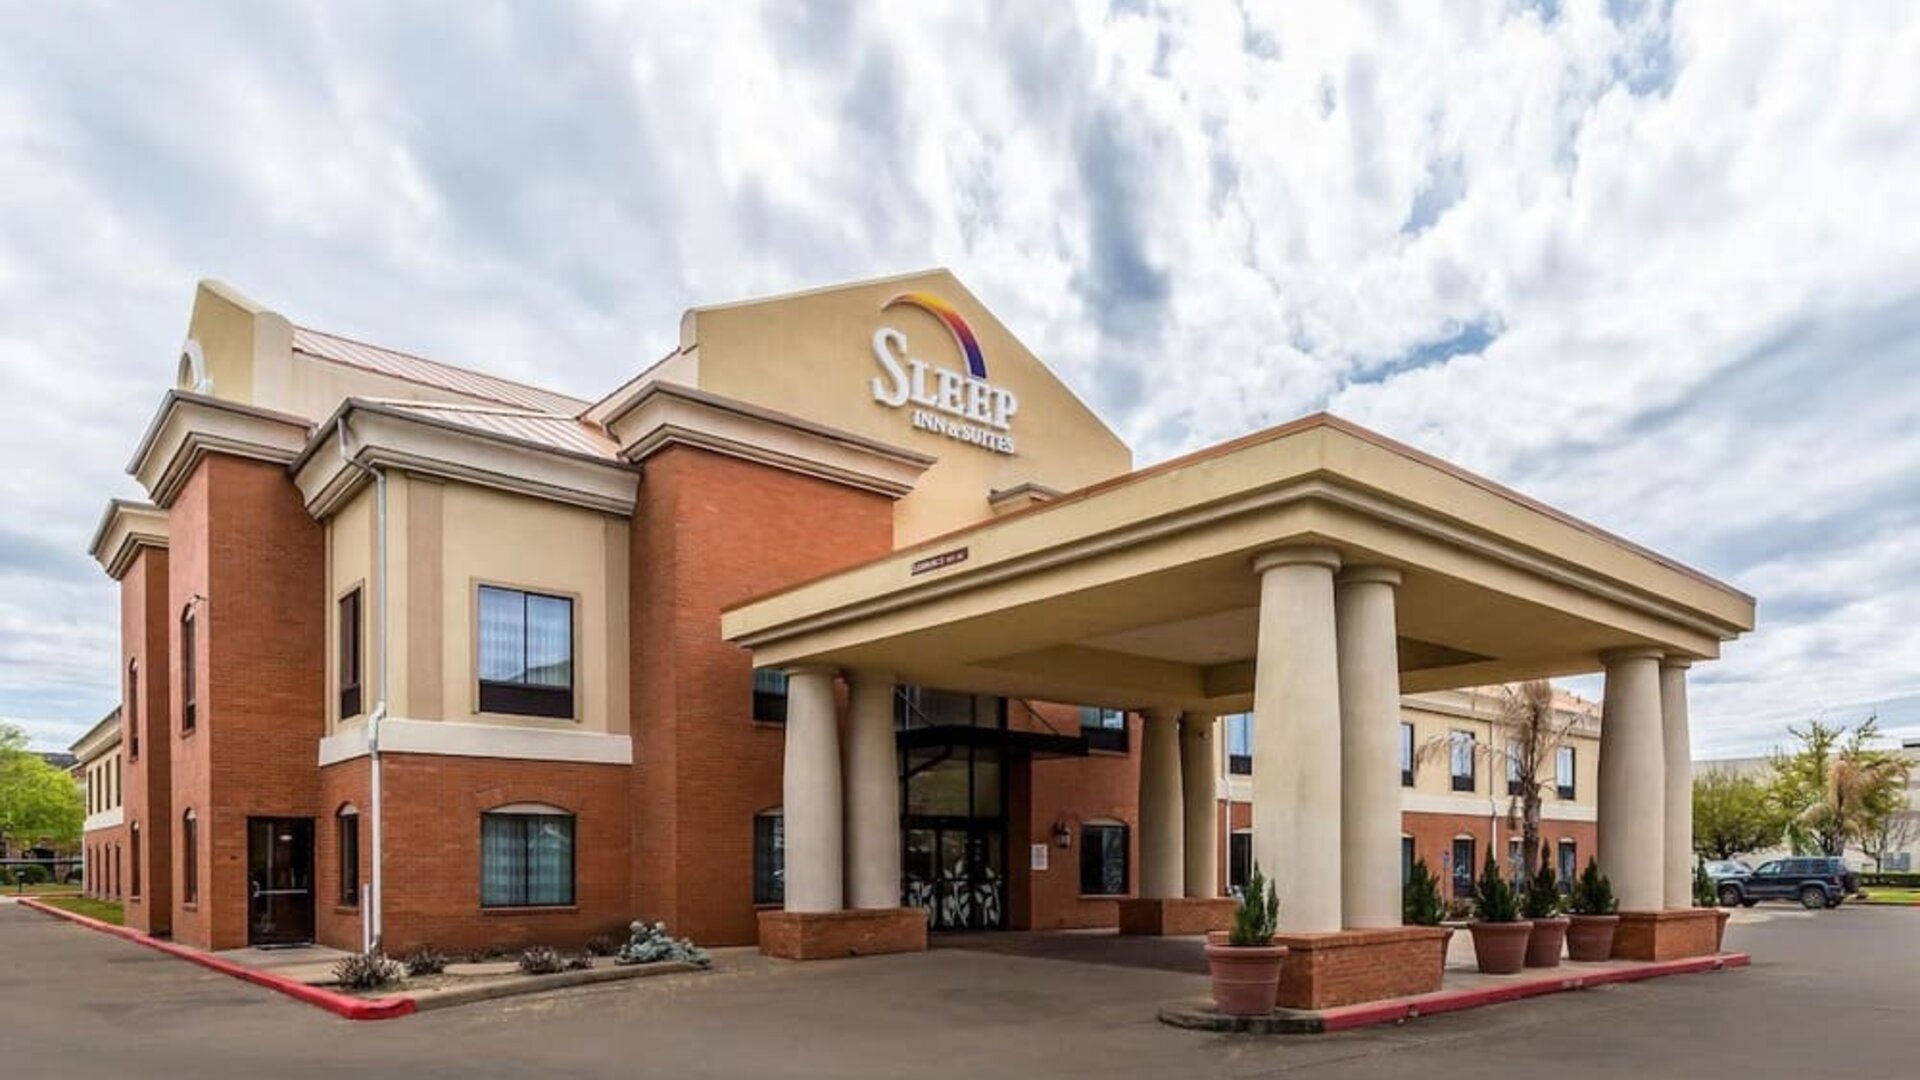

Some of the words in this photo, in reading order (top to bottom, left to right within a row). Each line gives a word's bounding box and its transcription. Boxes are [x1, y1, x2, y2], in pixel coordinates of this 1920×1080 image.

[872, 328, 1018, 430] SLEEP
[912, 409, 946, 433] INN
[947, 422, 961, 438] &
[961, 424, 1015, 453] SUITES
